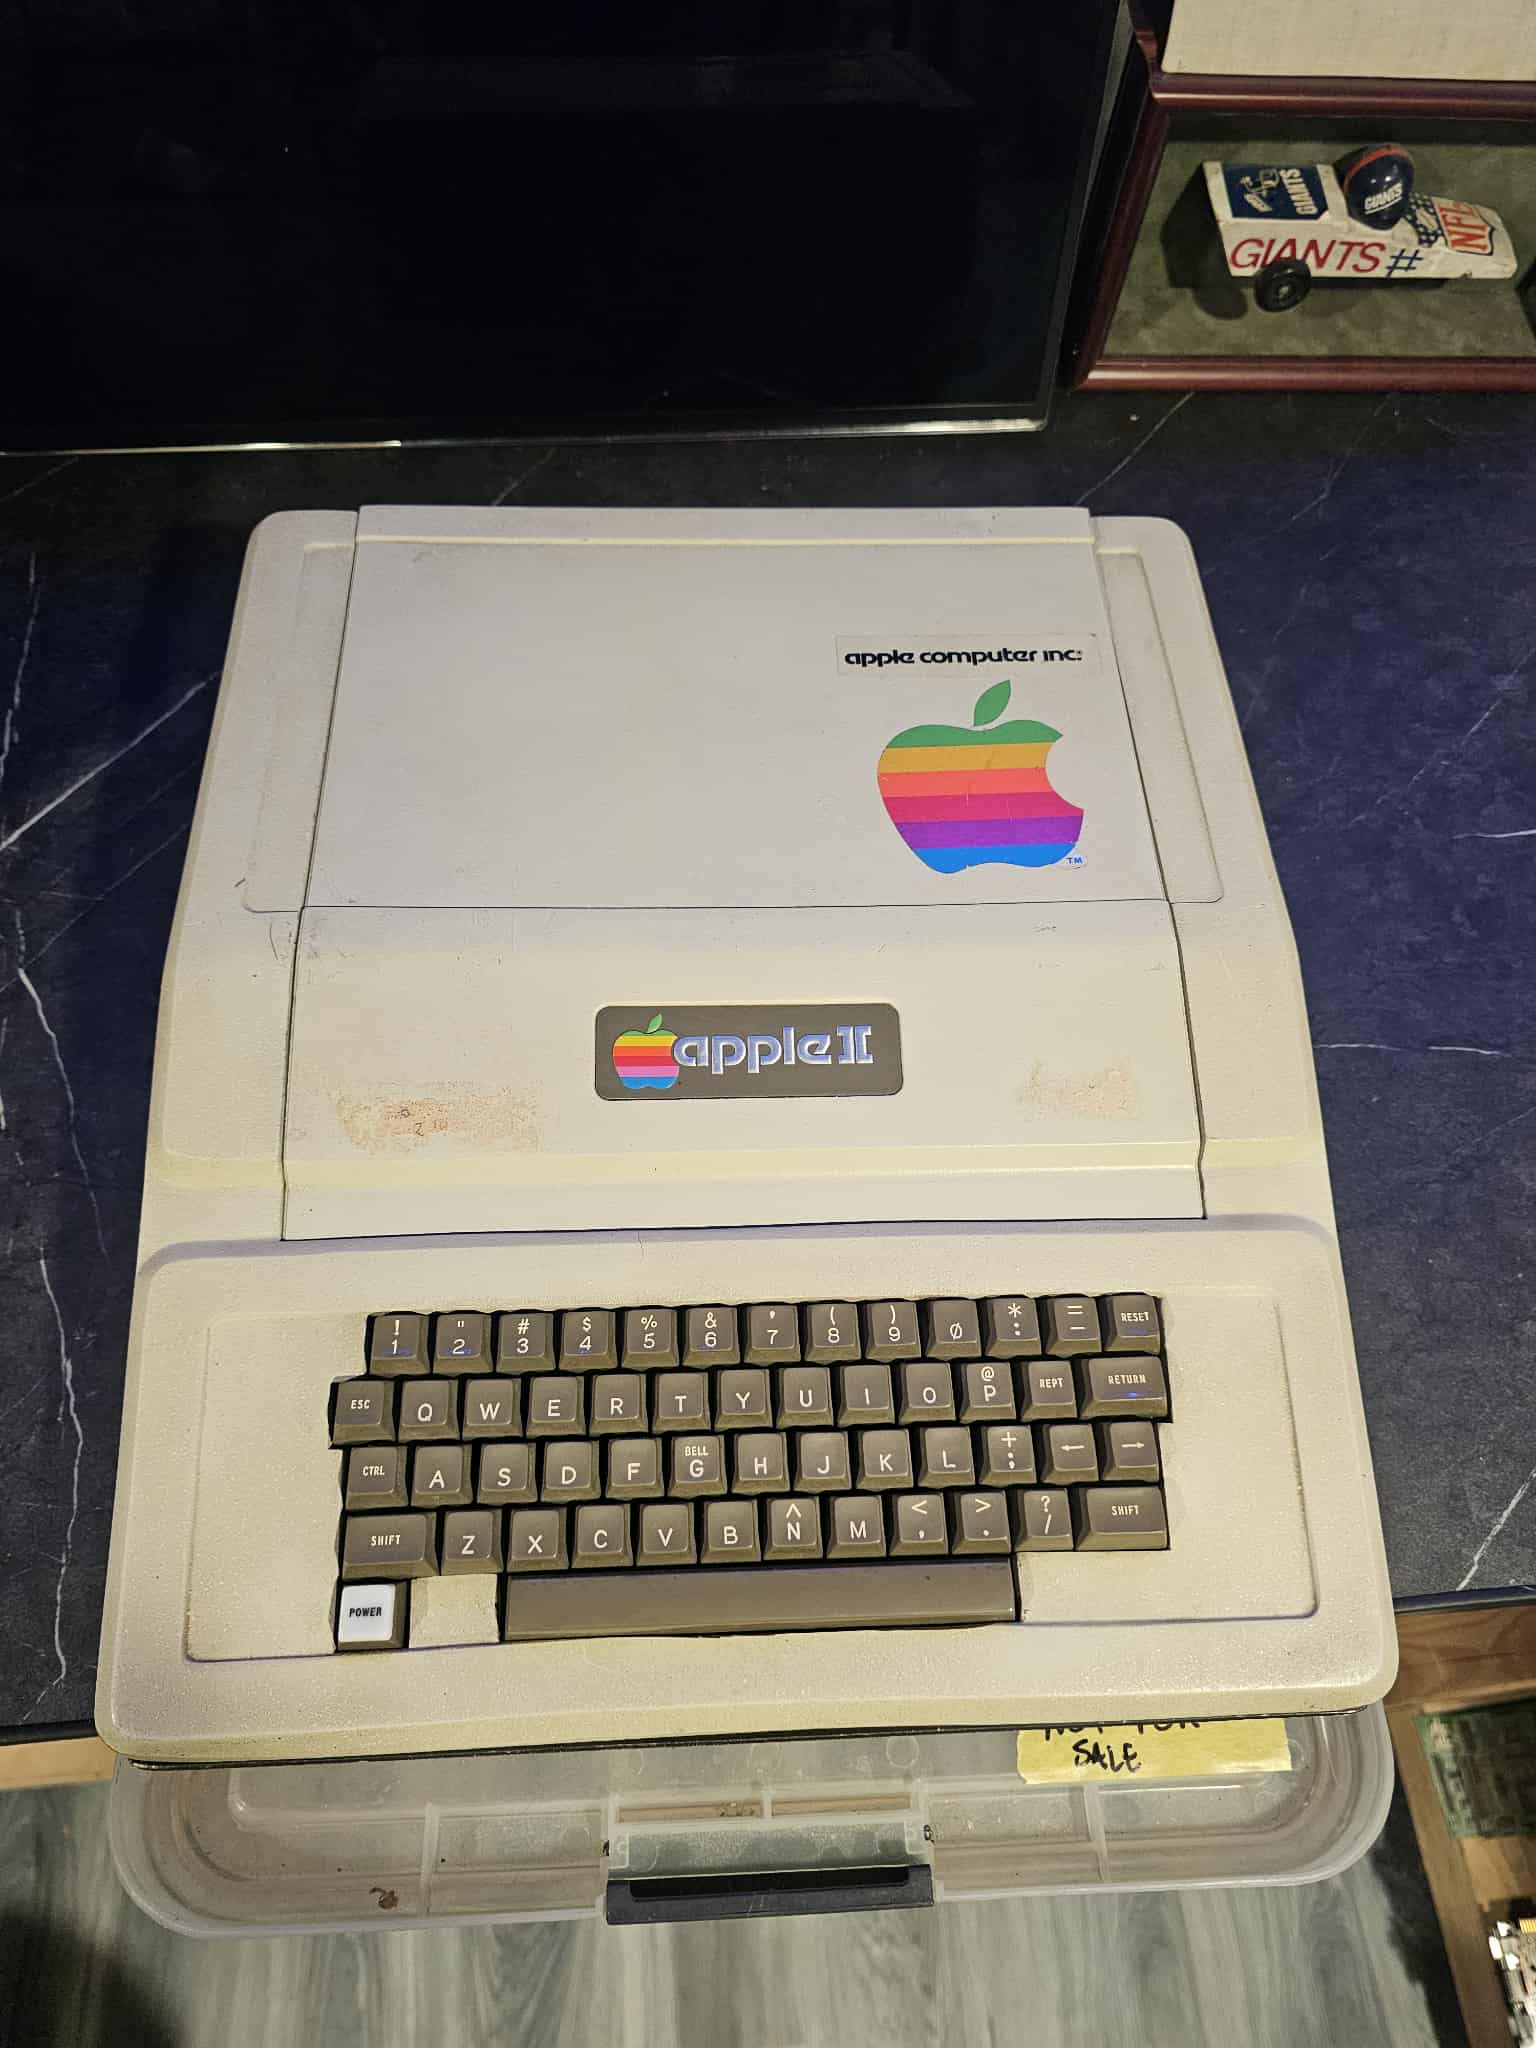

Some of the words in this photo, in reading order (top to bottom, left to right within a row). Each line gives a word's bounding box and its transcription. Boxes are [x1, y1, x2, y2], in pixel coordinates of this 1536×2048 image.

[1438, 201, 1489, 252] NFL
[1229, 236, 1388, 274] GIANTS
[844, 648, 915, 668] apple
[919, 647, 1039, 666] computer
[1066, 856, 1083, 865] TM
[640, 1314, 658, 1331] %
[704, 1311, 717, 1329] &
[830, 1306, 836, 1326] (
[889, 1304, 896, 1325] )
[1120, 1311, 1149, 1322] RESET
[394, 1319, 400, 1336] !
[517, 1318, 530, 1335] #
[582, 1316, 592, 1332] $
[579, 1335, 592, 1351] 4
[643, 1332, 656, 1349] 5
[704, 1331, 717, 1348] 6
[767, 1329, 779, 1345] 7
[827, 1327, 840, 1344] 8
[888, 1326, 901, 1342] 9
[391, 1339, 398, 1355] 1
[452, 1338, 466, 1355] 2
[516, 1337, 529, 1354] 3
[980, 1366, 995, 1382] @
[1039, 1377, 1063, 1389] REPT
[1107, 1374, 1146, 1385] RETURN
[735, 1391, 751, 1409] Y
[799, 1389, 813, 1408] U
[922, 1386, 937, 1404] O
[983, 1384, 997, 1402] P
[350, 1399, 371, 1410] ESC
[417, 1403, 433, 1422] Q
[479, 1402, 501, 1420] W
[547, 1399, 561, 1417] E
[610, 1397, 624, 1415] R
[674, 1395, 687, 1413] T
[1000, 1431, 1017, 1448] +
[684, 1445, 709, 1457] BELL
[942, 1449, 956, 1468] L
[362, 1465, 385, 1477] CTRL
[627, 1462, 641, 1481] F
[689, 1459, 704, 1478] G
[754, 1456, 768, 1475] H
[817, 1455, 830, 1474] J
[879, 1453, 893, 1472] K
[428, 1470, 445, 1489] A
[497, 1467, 511, 1487] S
[561, 1465, 577, 1485] D
[911, 1499, 928, 1515] <
[974, 1498, 991, 1513] >
[1040, 1495, 1051, 1513] ?
[1111, 1504, 1139, 1516] SHIFT
[657, 1527, 673, 1547] V
[723, 1525, 738, 1545] B
[787, 1521, 801, 1541] N
[849, 1520, 867, 1539] M
[370, 1534, 401, 1547] SHIFT
[461, 1535, 476, 1555] Z
[527, 1534, 543, 1554] X
[593, 1529, 608, 1549] C
[348, 1605, 383, 1619] POWER
[1071, 1737, 1143, 1774] SALE
